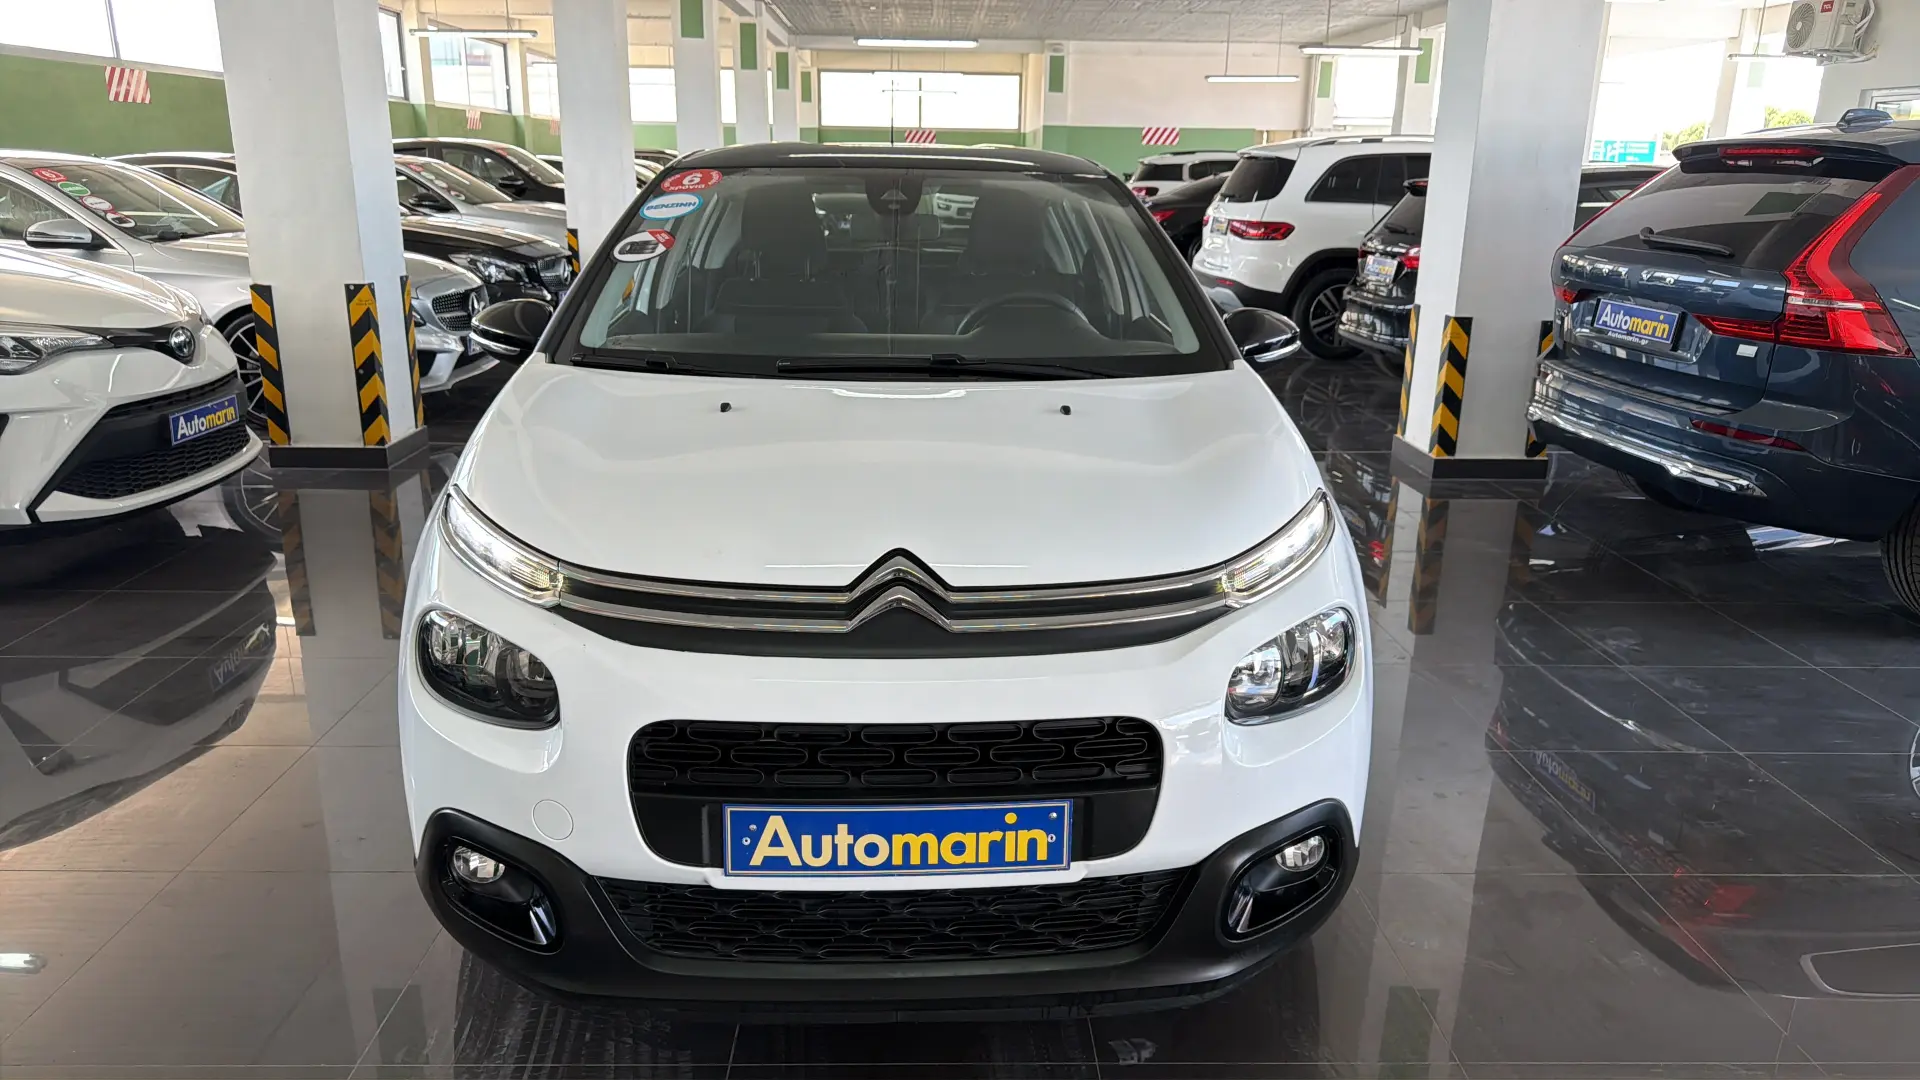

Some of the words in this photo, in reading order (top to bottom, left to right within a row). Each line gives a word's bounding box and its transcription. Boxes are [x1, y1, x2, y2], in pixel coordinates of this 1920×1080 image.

[682, 173, 703, 185] 6
[1599, 303, 1670, 339] Automarin
[1607, 330, 1649, 346] Automarin.gr
[177, 400, 236, 440] Automarin
[748, 812, 1049, 867] Automarin
